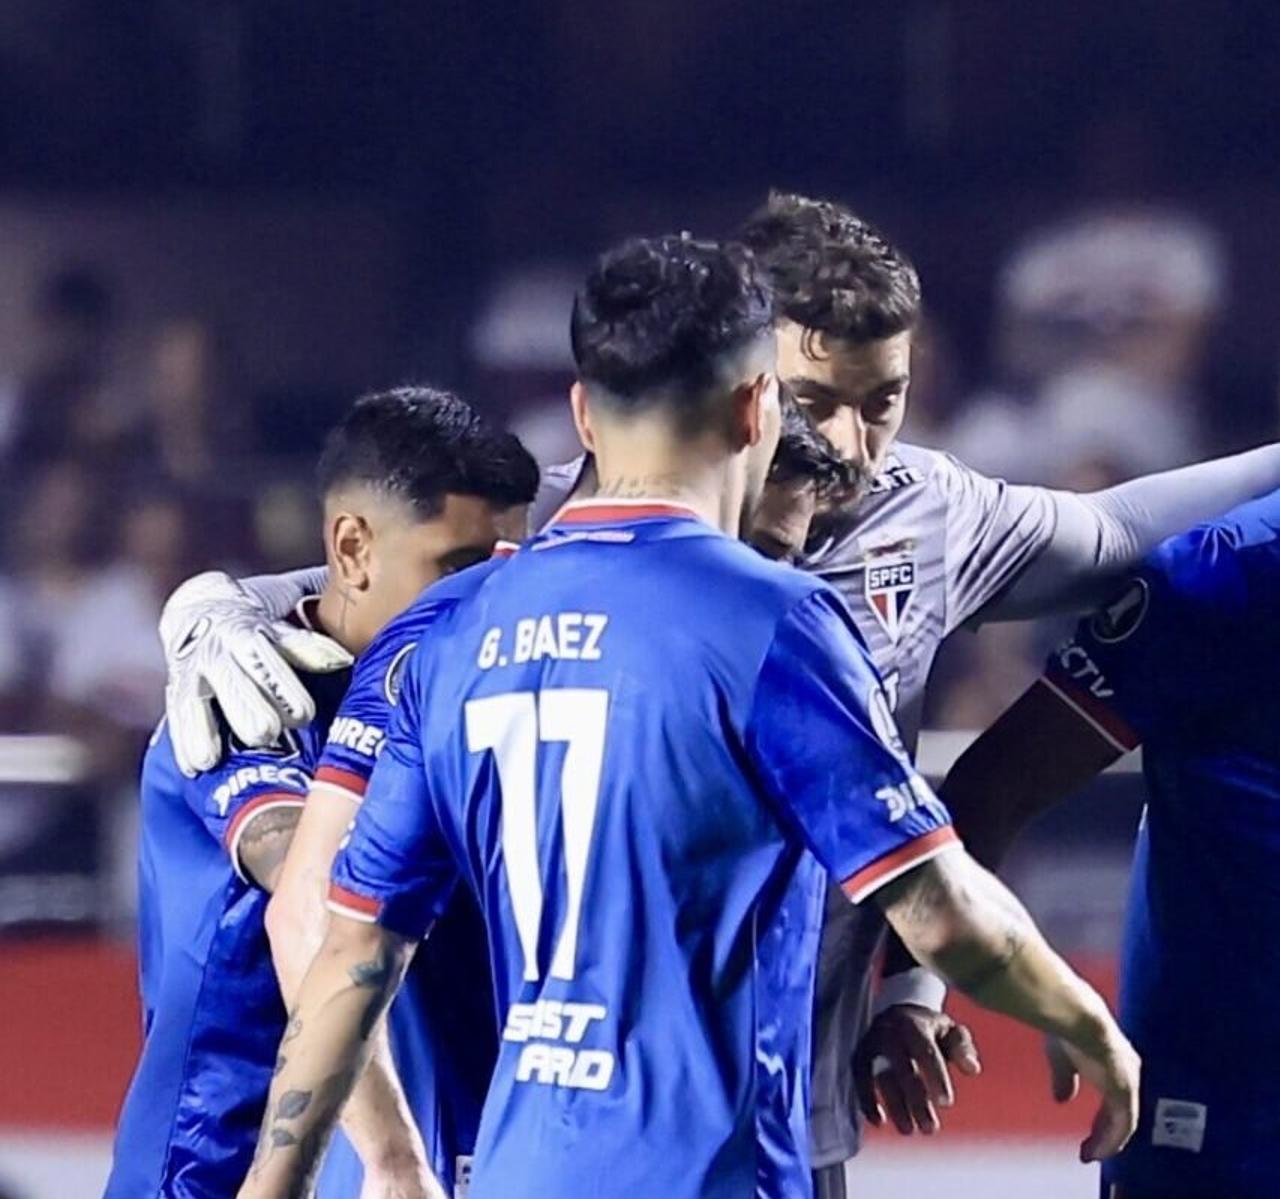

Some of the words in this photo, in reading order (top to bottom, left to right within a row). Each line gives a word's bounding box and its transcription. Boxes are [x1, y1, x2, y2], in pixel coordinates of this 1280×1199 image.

[869, 563, 913, 589] SPFC
[477, 627, 508, 670] G.
[513, 612, 609, 663] BAEZ
[464, 687, 608, 982] 77
